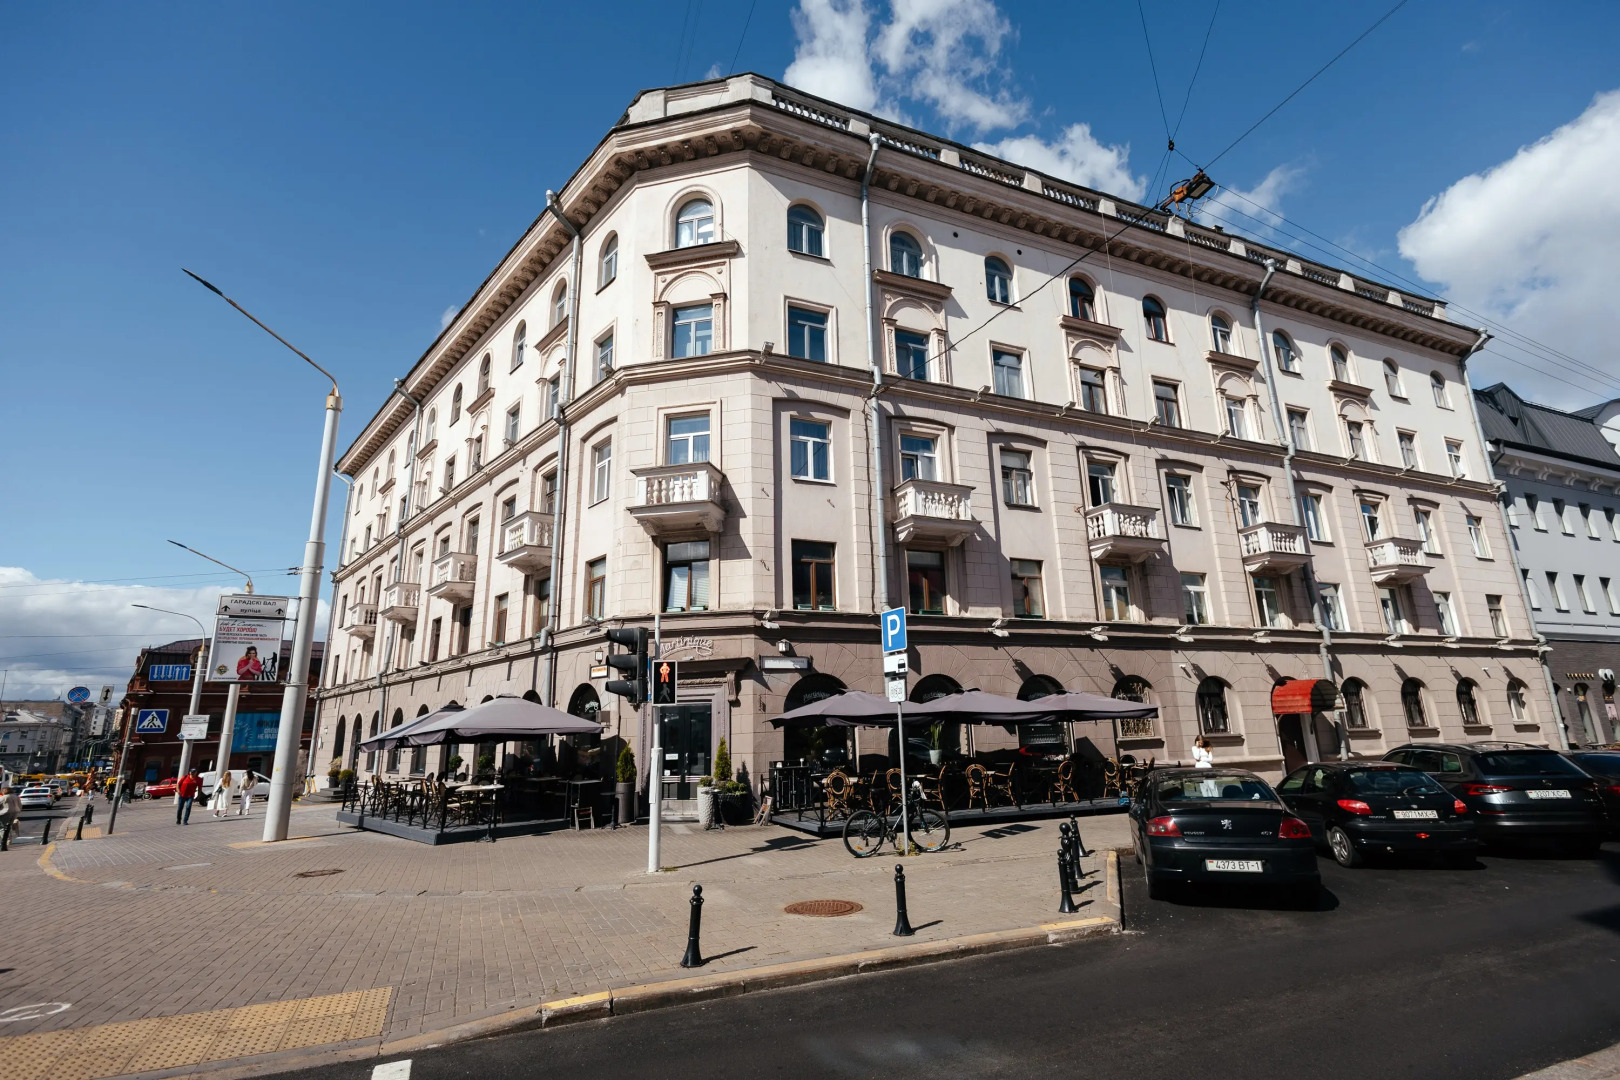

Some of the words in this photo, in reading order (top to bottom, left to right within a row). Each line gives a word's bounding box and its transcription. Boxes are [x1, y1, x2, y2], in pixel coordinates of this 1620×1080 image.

[887, 614, 901, 648] P
[1215, 860, 1236, 870] 4373
[1238, 861, 1260, 871] BT-1
